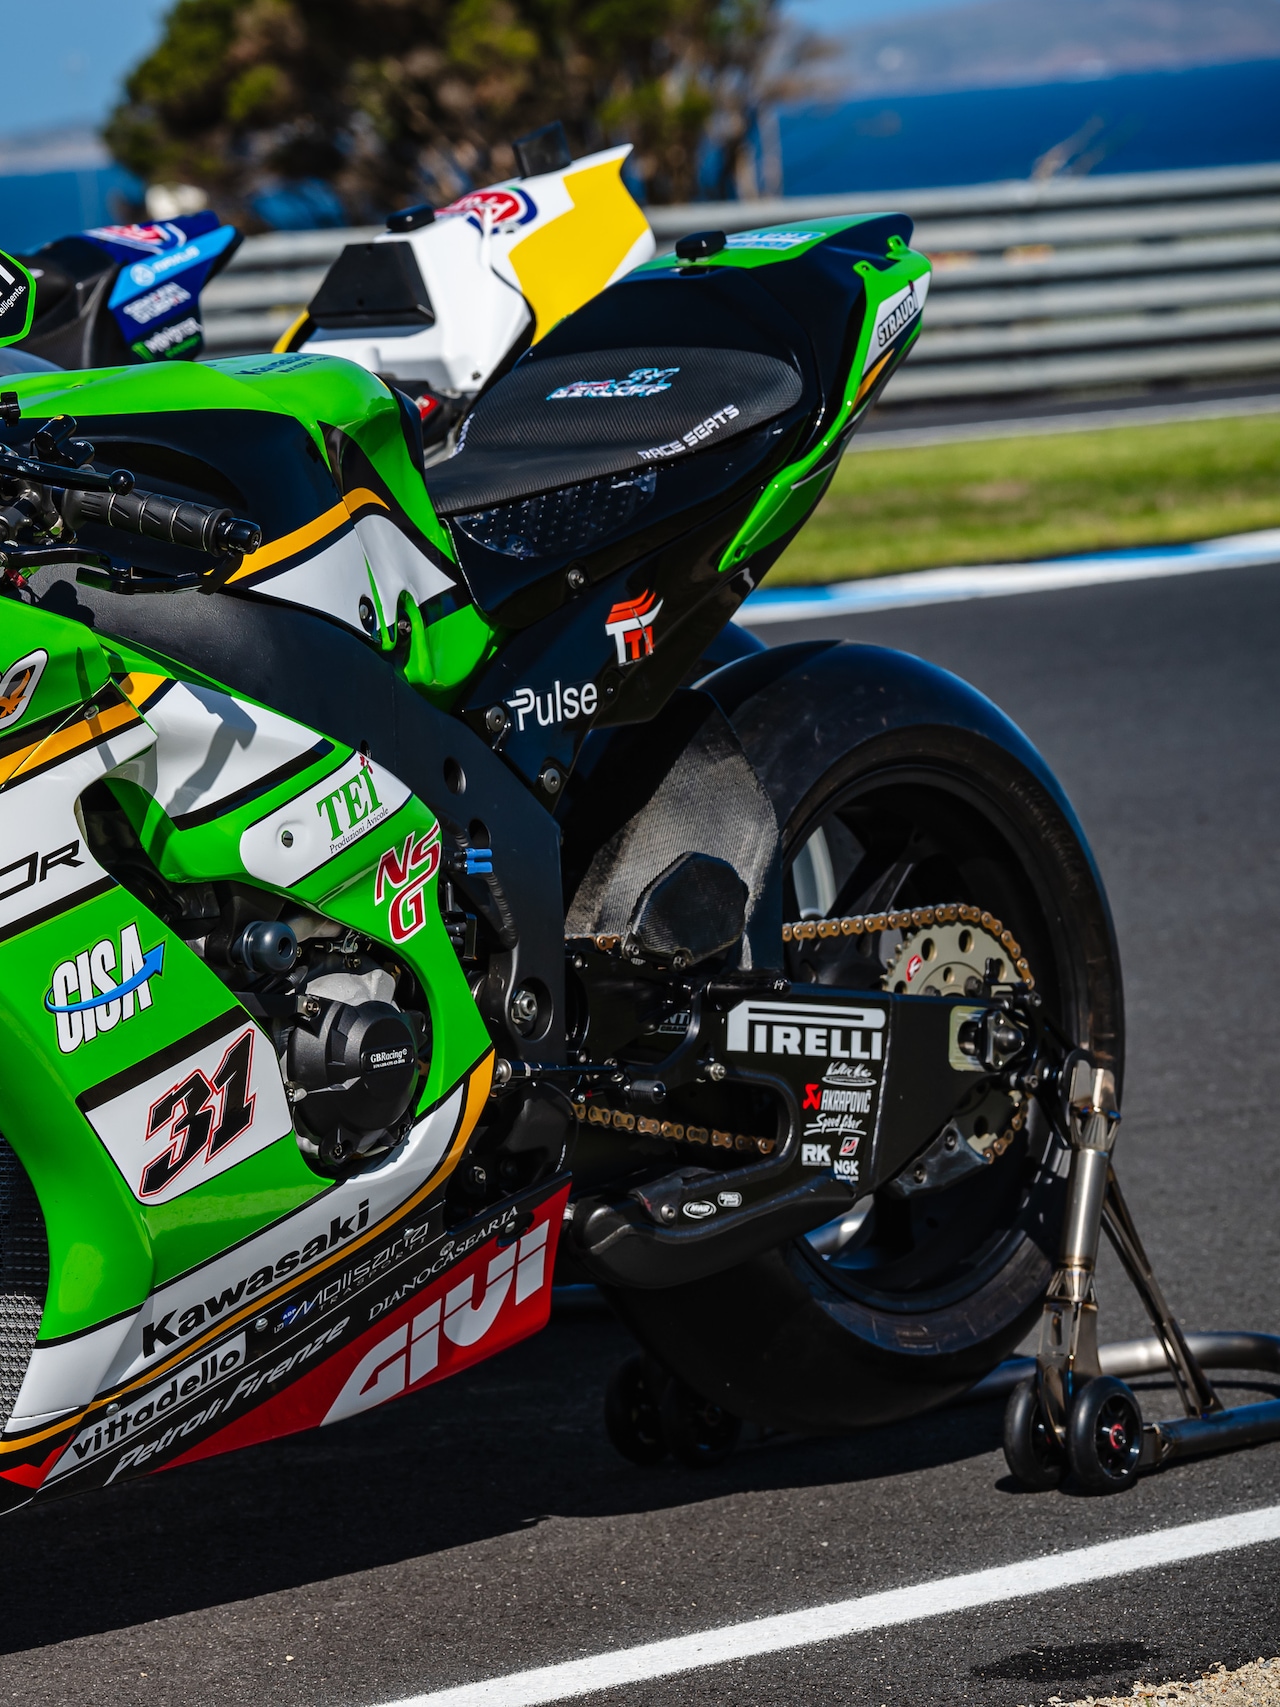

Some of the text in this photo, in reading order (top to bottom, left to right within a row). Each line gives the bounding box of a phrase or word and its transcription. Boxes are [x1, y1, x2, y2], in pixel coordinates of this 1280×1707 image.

[637, 403, 741, 460] RACE SEATS
[506, 679, 598, 732] Pulse
[316, 764, 383, 841] TEI
[366, 806, 389, 832] Avicole
[328, 822, 366, 854] Produzioni
[50, 921, 155, 1055] CISA
[726, 999, 887, 1061] PIRELLI
[138, 1028, 258, 1199] 31
[820, 1089, 872, 1114] AKRAPOVIČ
[802, 1143, 831, 1162] RK
[833, 1160, 859, 1175] NGK
[141, 1199, 370, 1359] Kawasaki
[320, 1218, 551, 1428] GIVI
[72, 1349, 241, 1460] vittadello
[103, 1316, 351, 1487] Petroli Firenze
